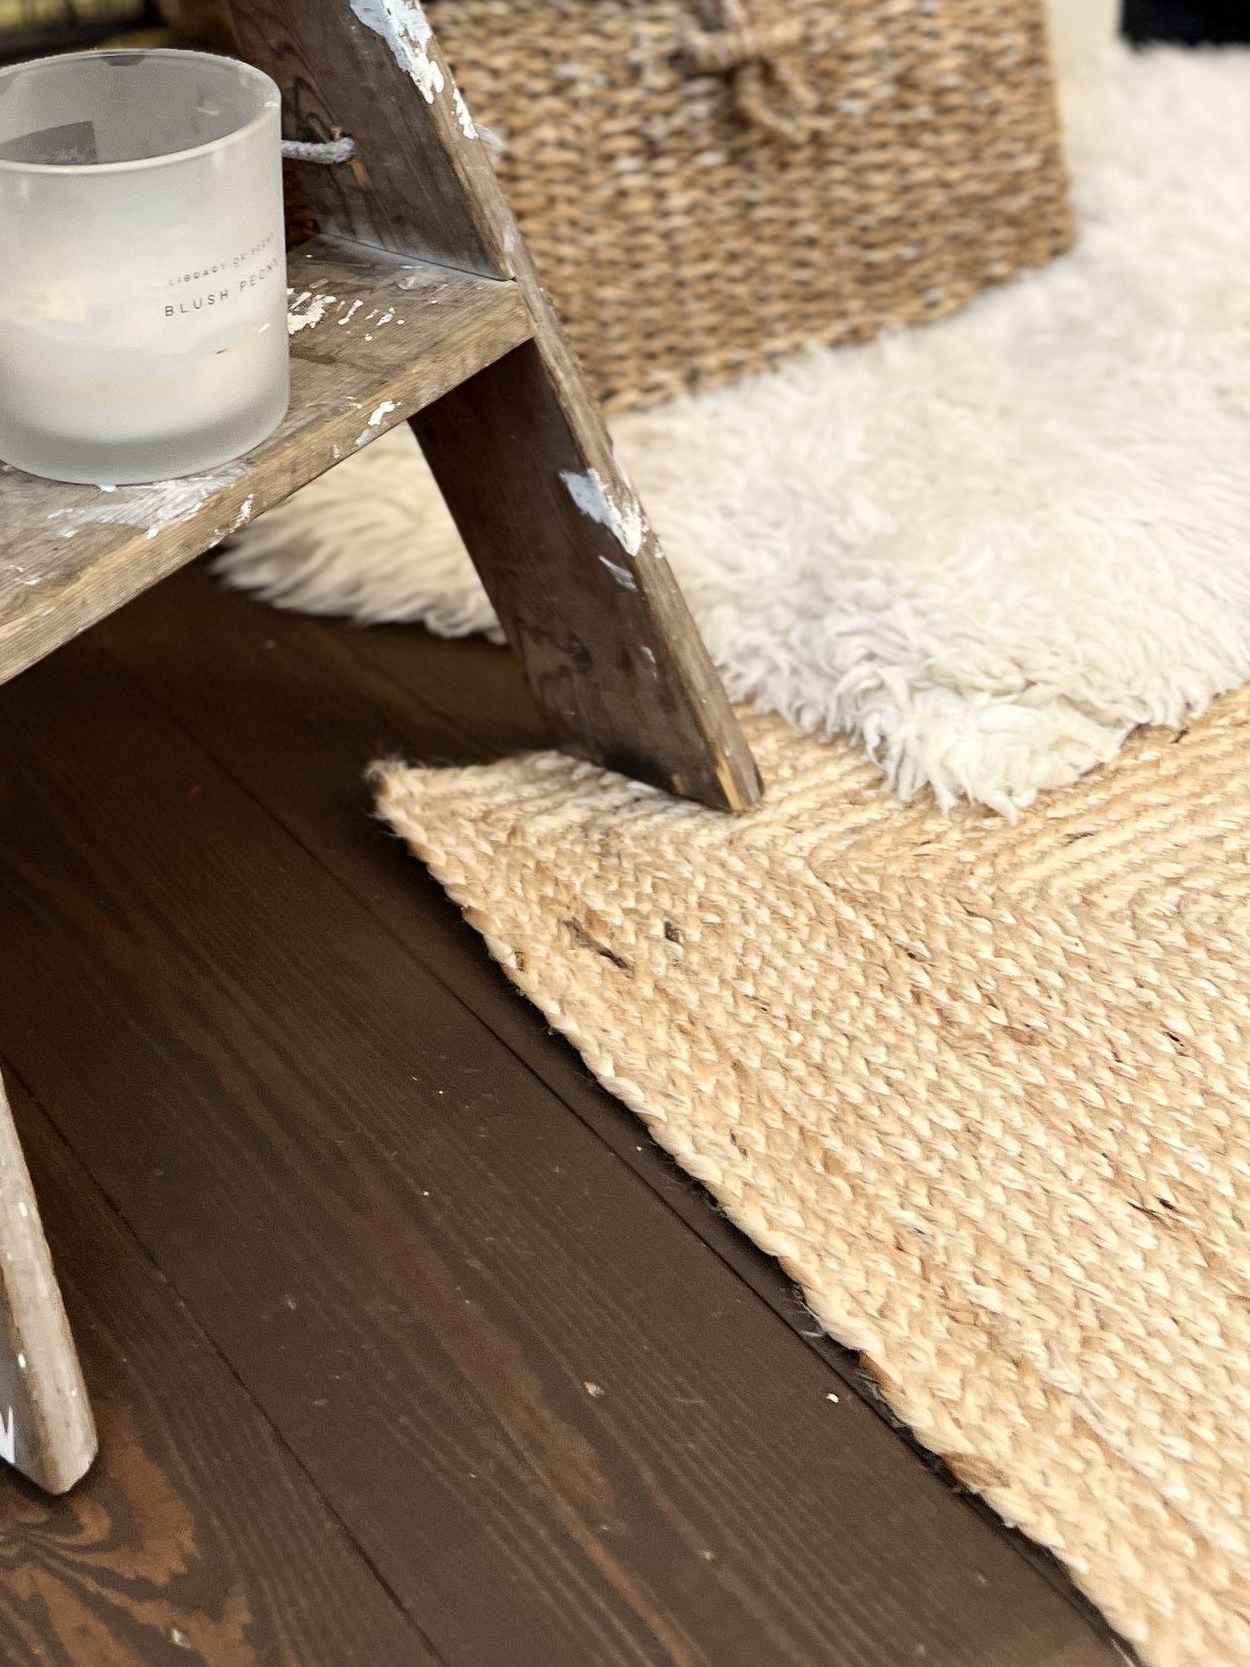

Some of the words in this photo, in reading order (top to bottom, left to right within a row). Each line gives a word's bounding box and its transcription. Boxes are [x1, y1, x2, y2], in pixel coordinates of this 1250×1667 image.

[164, 289, 229, 317] BLUSH
[239, 257, 279, 292] PEONY
[168, 261, 226, 287] LIBRARY
